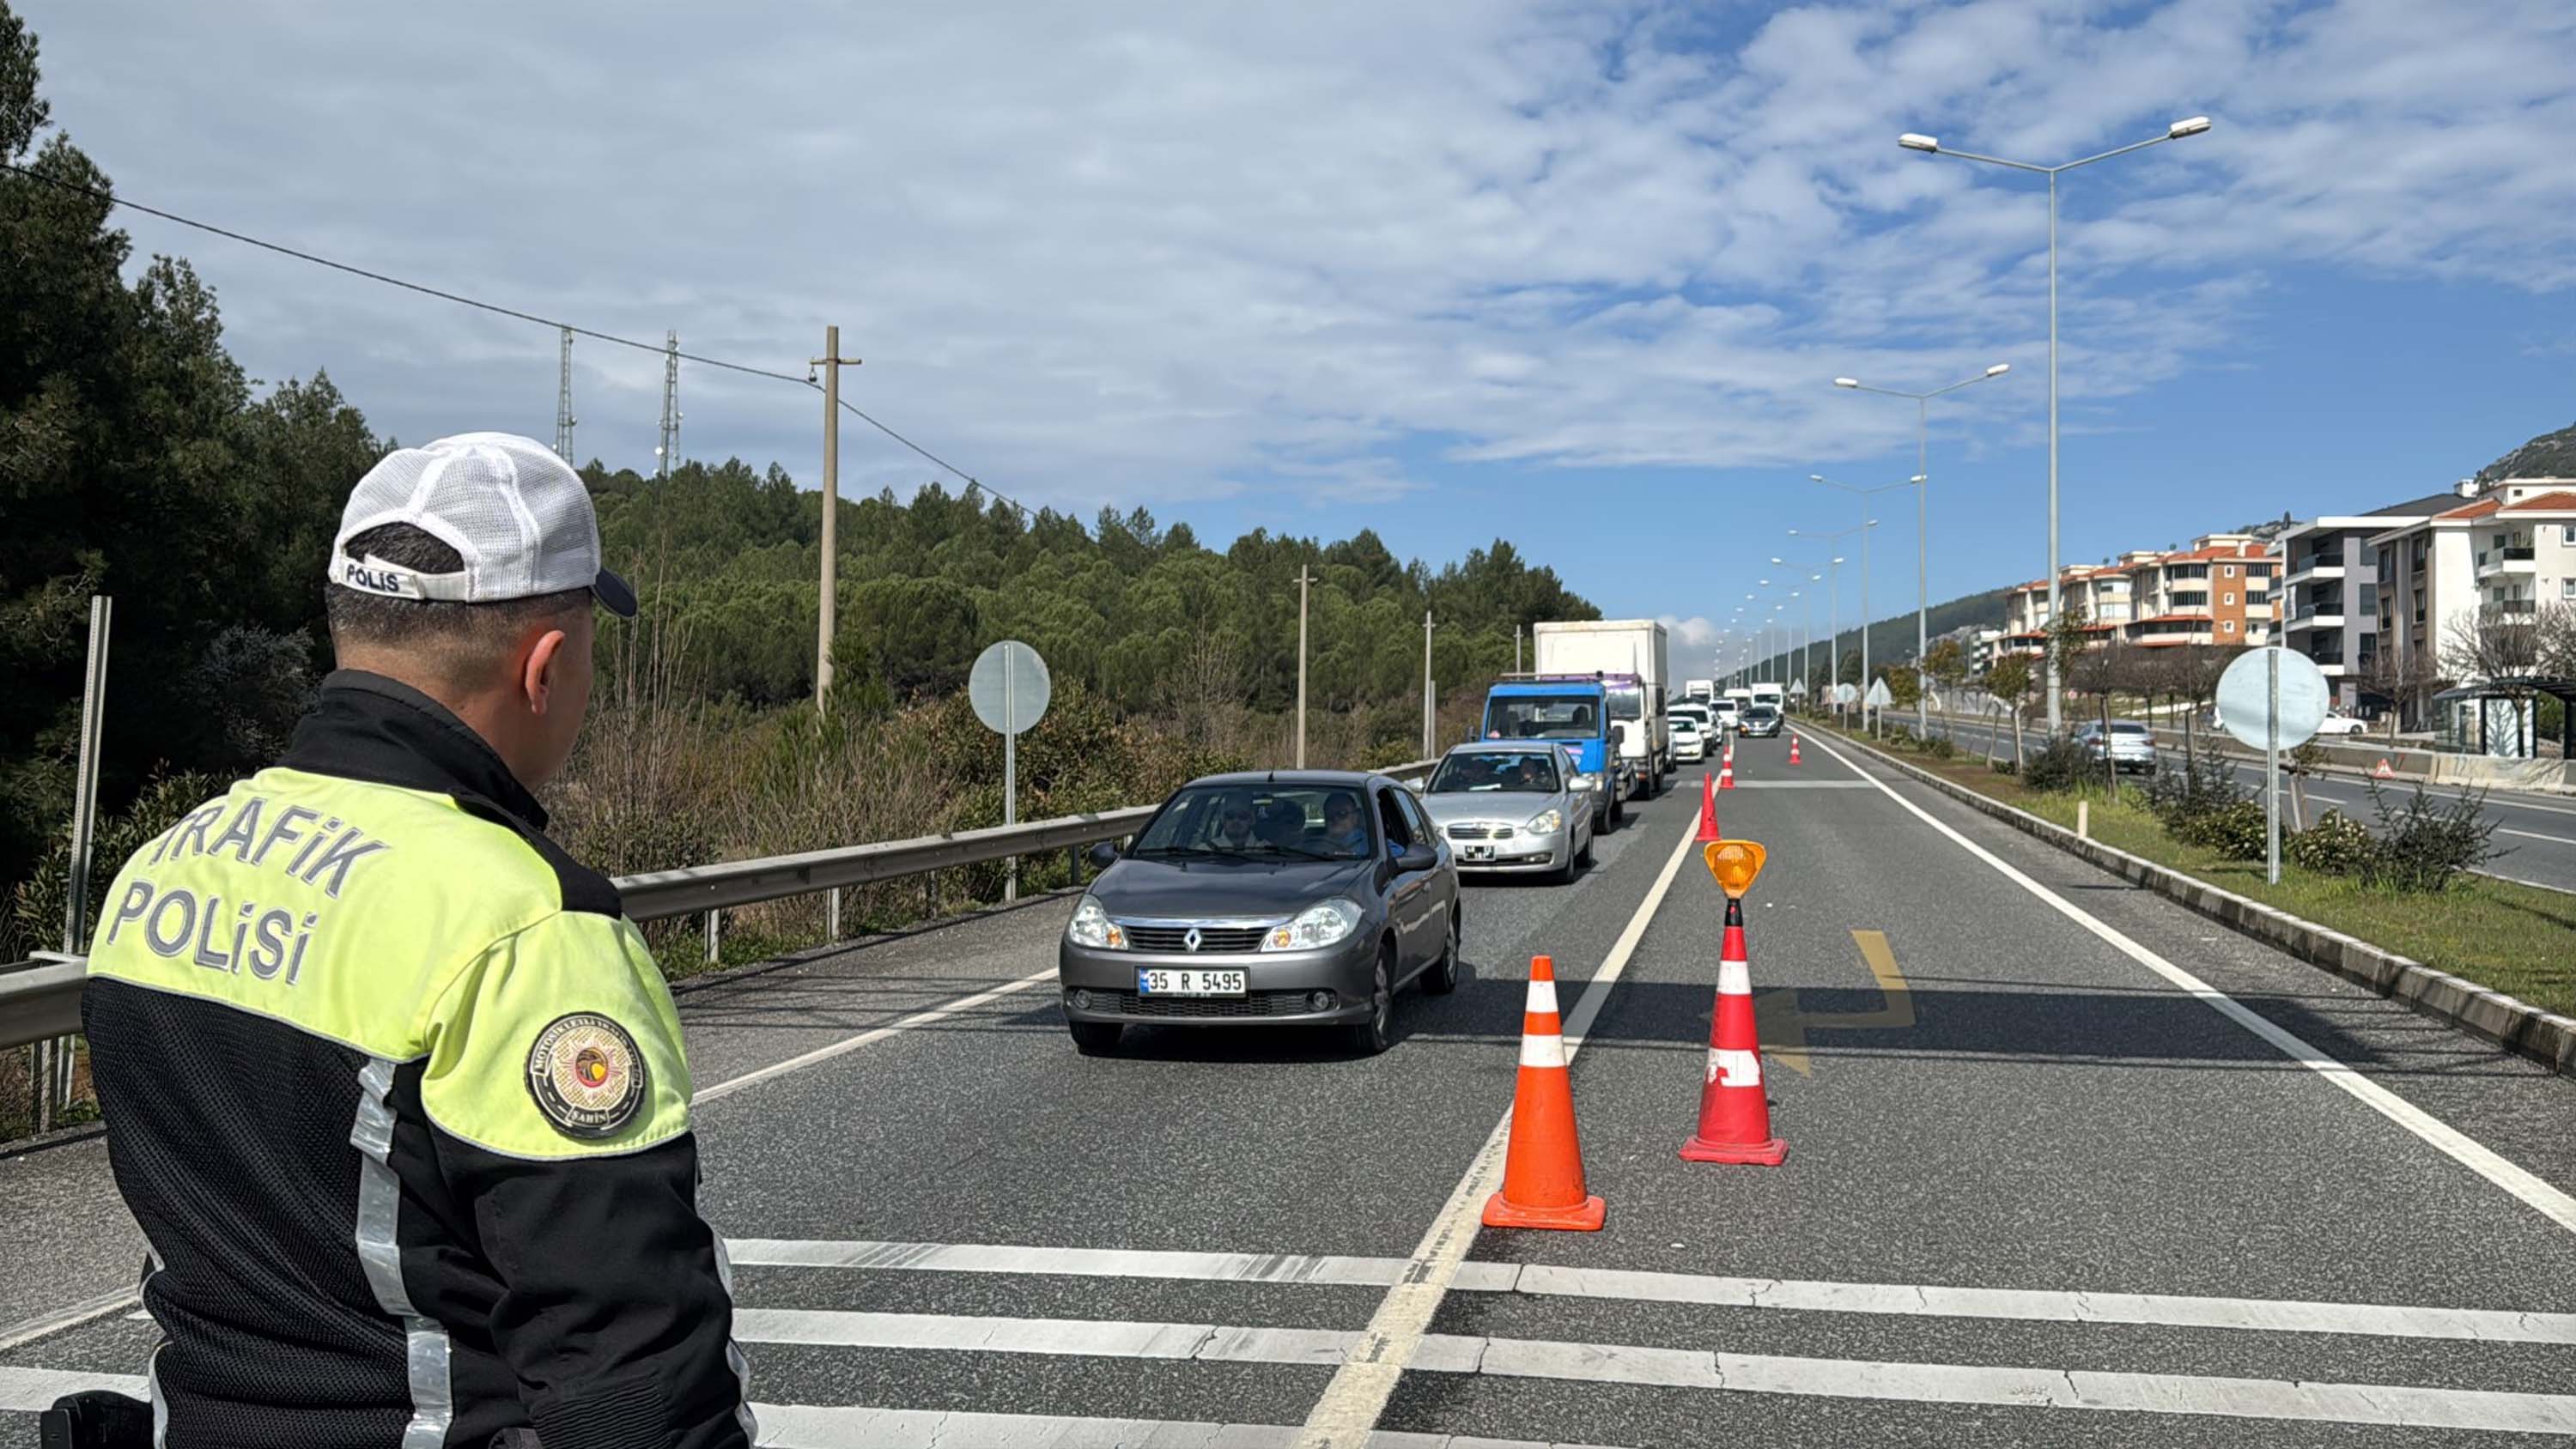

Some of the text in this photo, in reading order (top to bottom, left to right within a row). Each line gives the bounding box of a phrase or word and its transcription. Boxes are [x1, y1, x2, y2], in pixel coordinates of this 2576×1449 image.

[347, 564, 399, 591] POLİS
[149, 797, 392, 899] TRAFİK
[106, 879, 319, 985] POLİSİ
[1149, 972, 1242, 991] 35 R 5495
